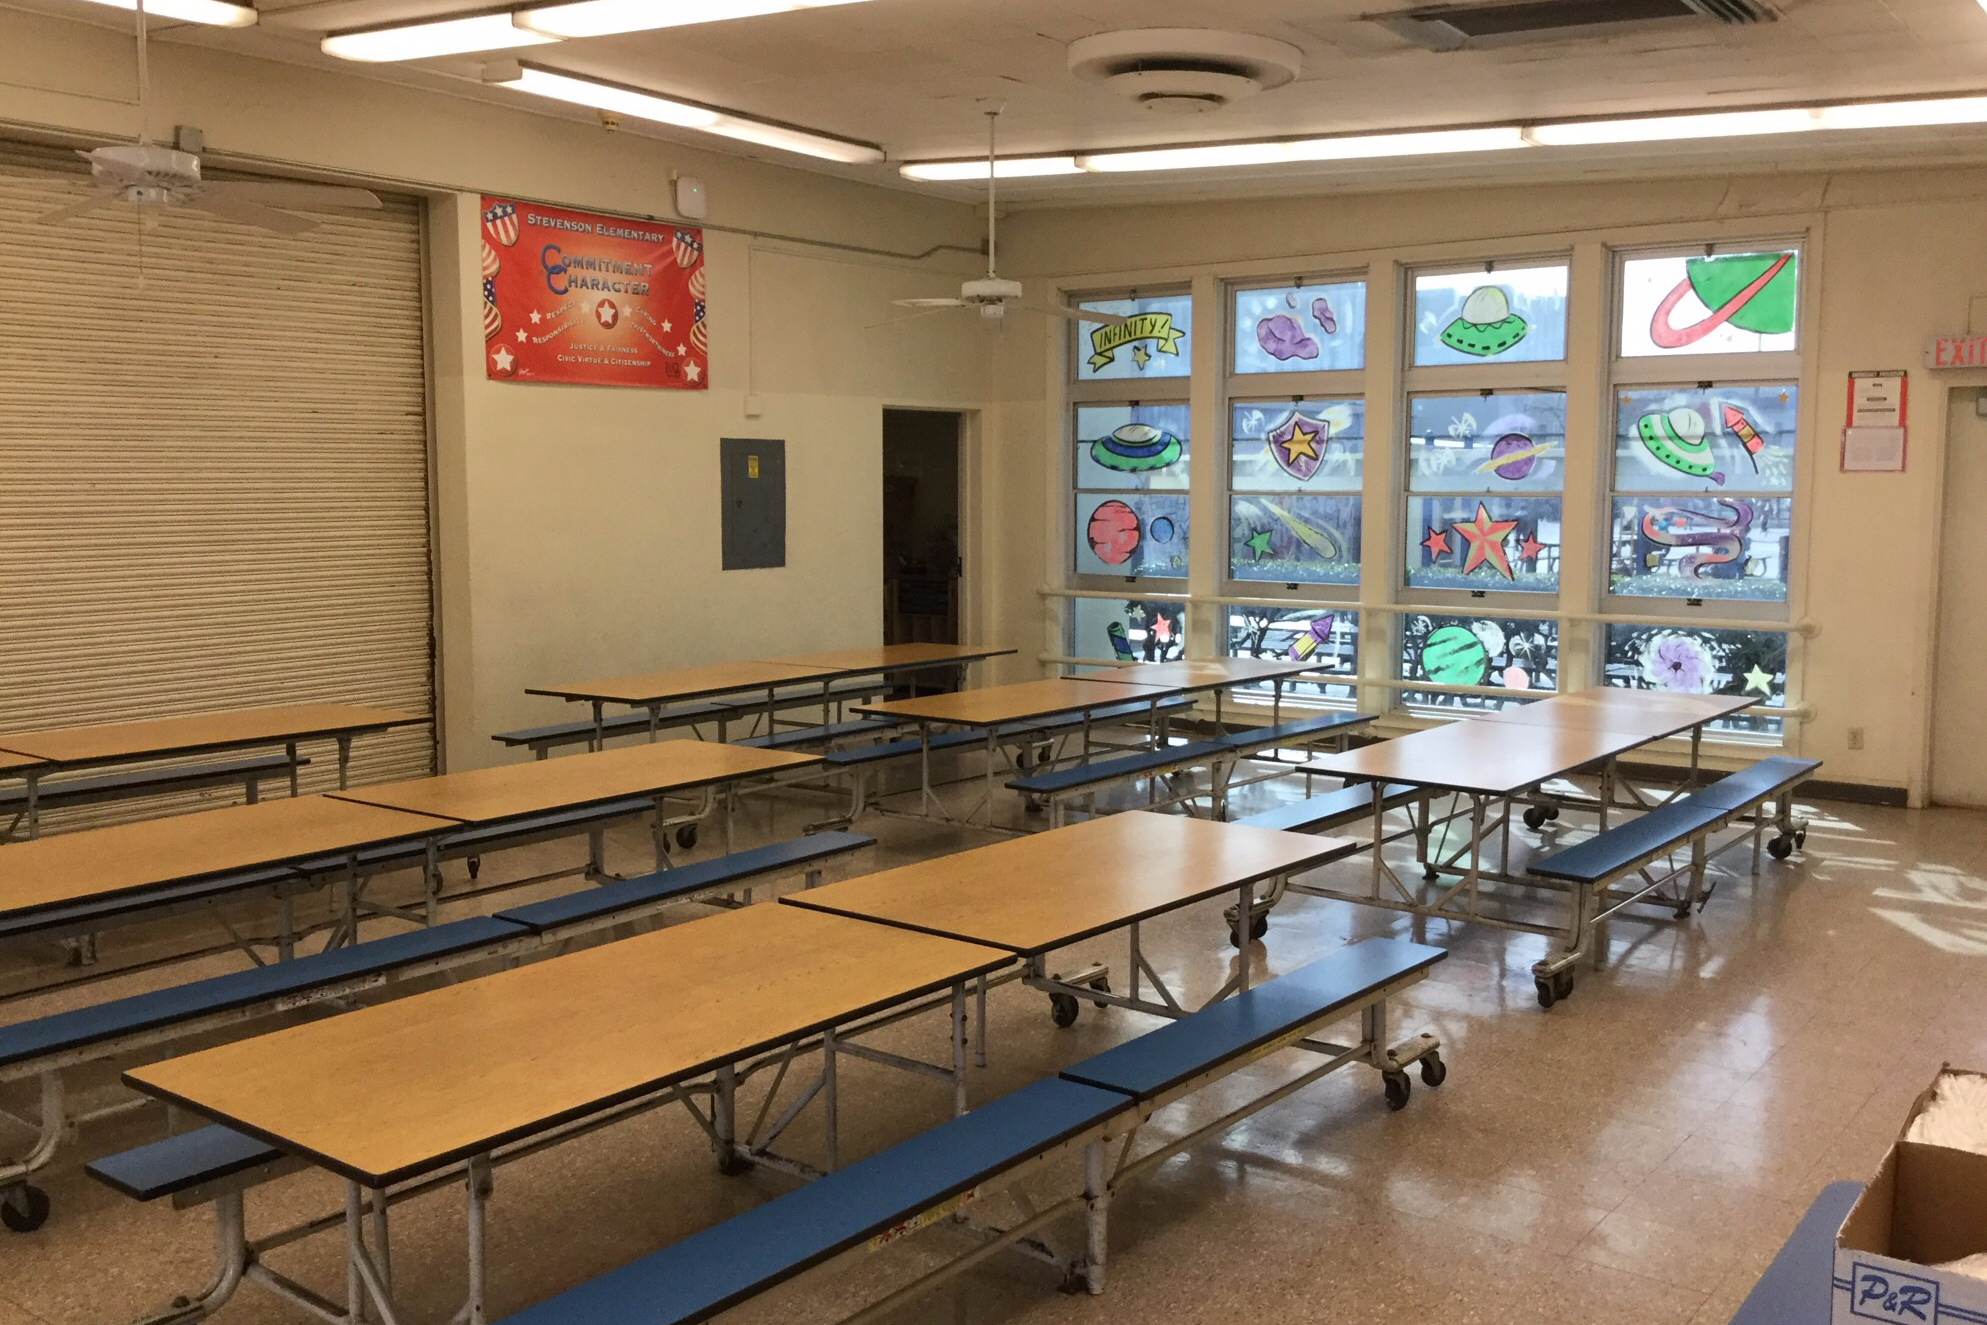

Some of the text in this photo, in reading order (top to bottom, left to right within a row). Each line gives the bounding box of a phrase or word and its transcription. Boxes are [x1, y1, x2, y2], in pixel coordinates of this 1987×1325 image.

[527, 213, 664, 243] STEVENSON ELEMENTARY
[541, 243, 653, 277] COMMITMENT
[546, 265, 650, 296] CHARACTER
[546, 301, 576, 320] RESPECT
[635, 306, 657, 326] CARING
[1099, 318, 1169, 348] INFINITY!
[557, 354, 575, 362] CIVIC
[578, 355, 602, 364] VIRTUE
[610, 357, 651, 367] CITIZENSHIP
[569, 343, 598, 351] JUSTICE
[607, 345, 638, 354] FAIRNESS
[1859, 1274, 1932, 1321] P&R
